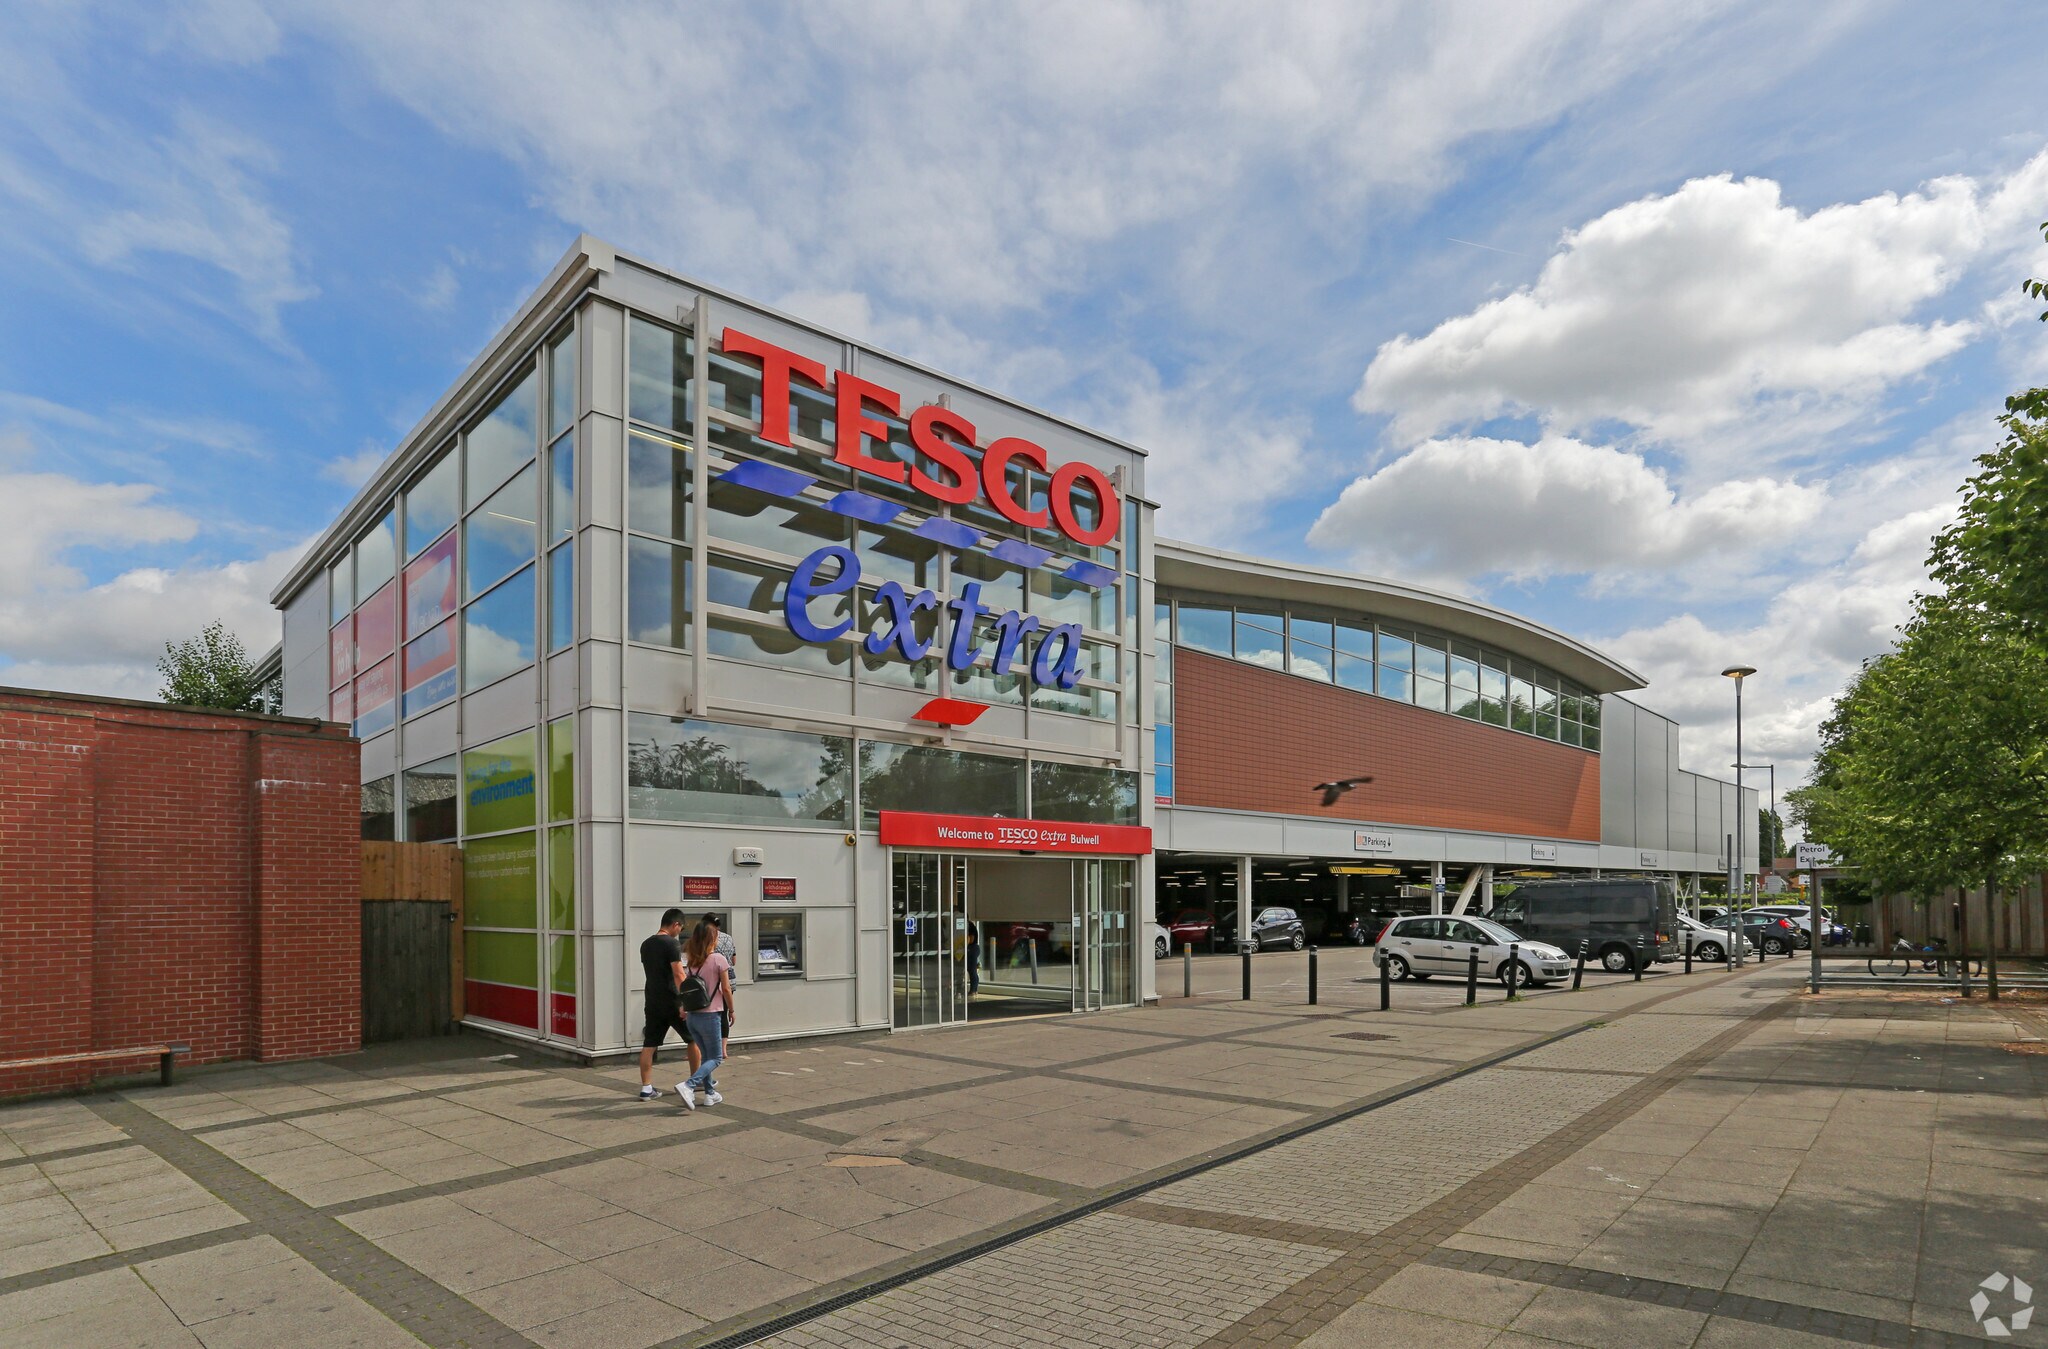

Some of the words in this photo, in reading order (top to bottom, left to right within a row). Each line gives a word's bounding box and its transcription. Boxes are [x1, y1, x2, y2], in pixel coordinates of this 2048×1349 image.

[722, 326, 1120, 547] TESCO
[784, 545, 1085, 690] extra
[471, 770, 534, 807] environment
[937, 826, 983, 840] Welcome
[984, 830, 994, 840] to
[998, 827, 1038, 840] TESCO
[1040, 829, 1067, 842] extra
[1070, 833, 1100, 845] Bulwell
[1367, 837, 1386, 848] Parking
